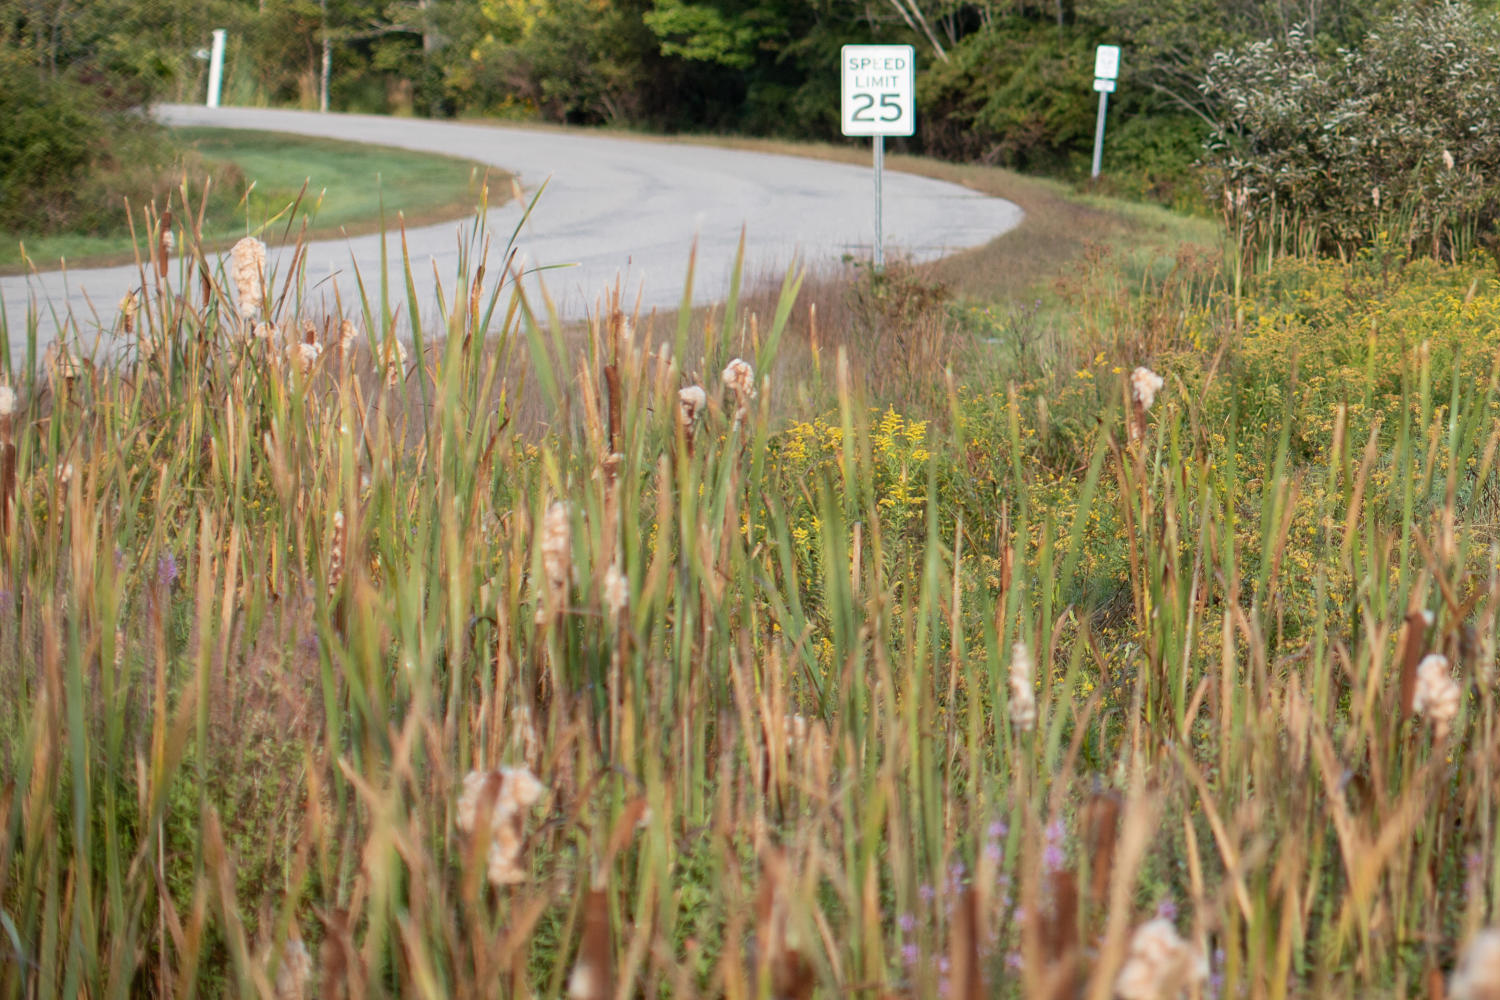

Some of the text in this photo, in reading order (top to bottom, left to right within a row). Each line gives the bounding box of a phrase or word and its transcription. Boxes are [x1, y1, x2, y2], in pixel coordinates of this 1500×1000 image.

[849, 57, 905, 70] SPEED
[855, 75, 899, 88] LIMIT
[851, 93, 903, 122] 25
